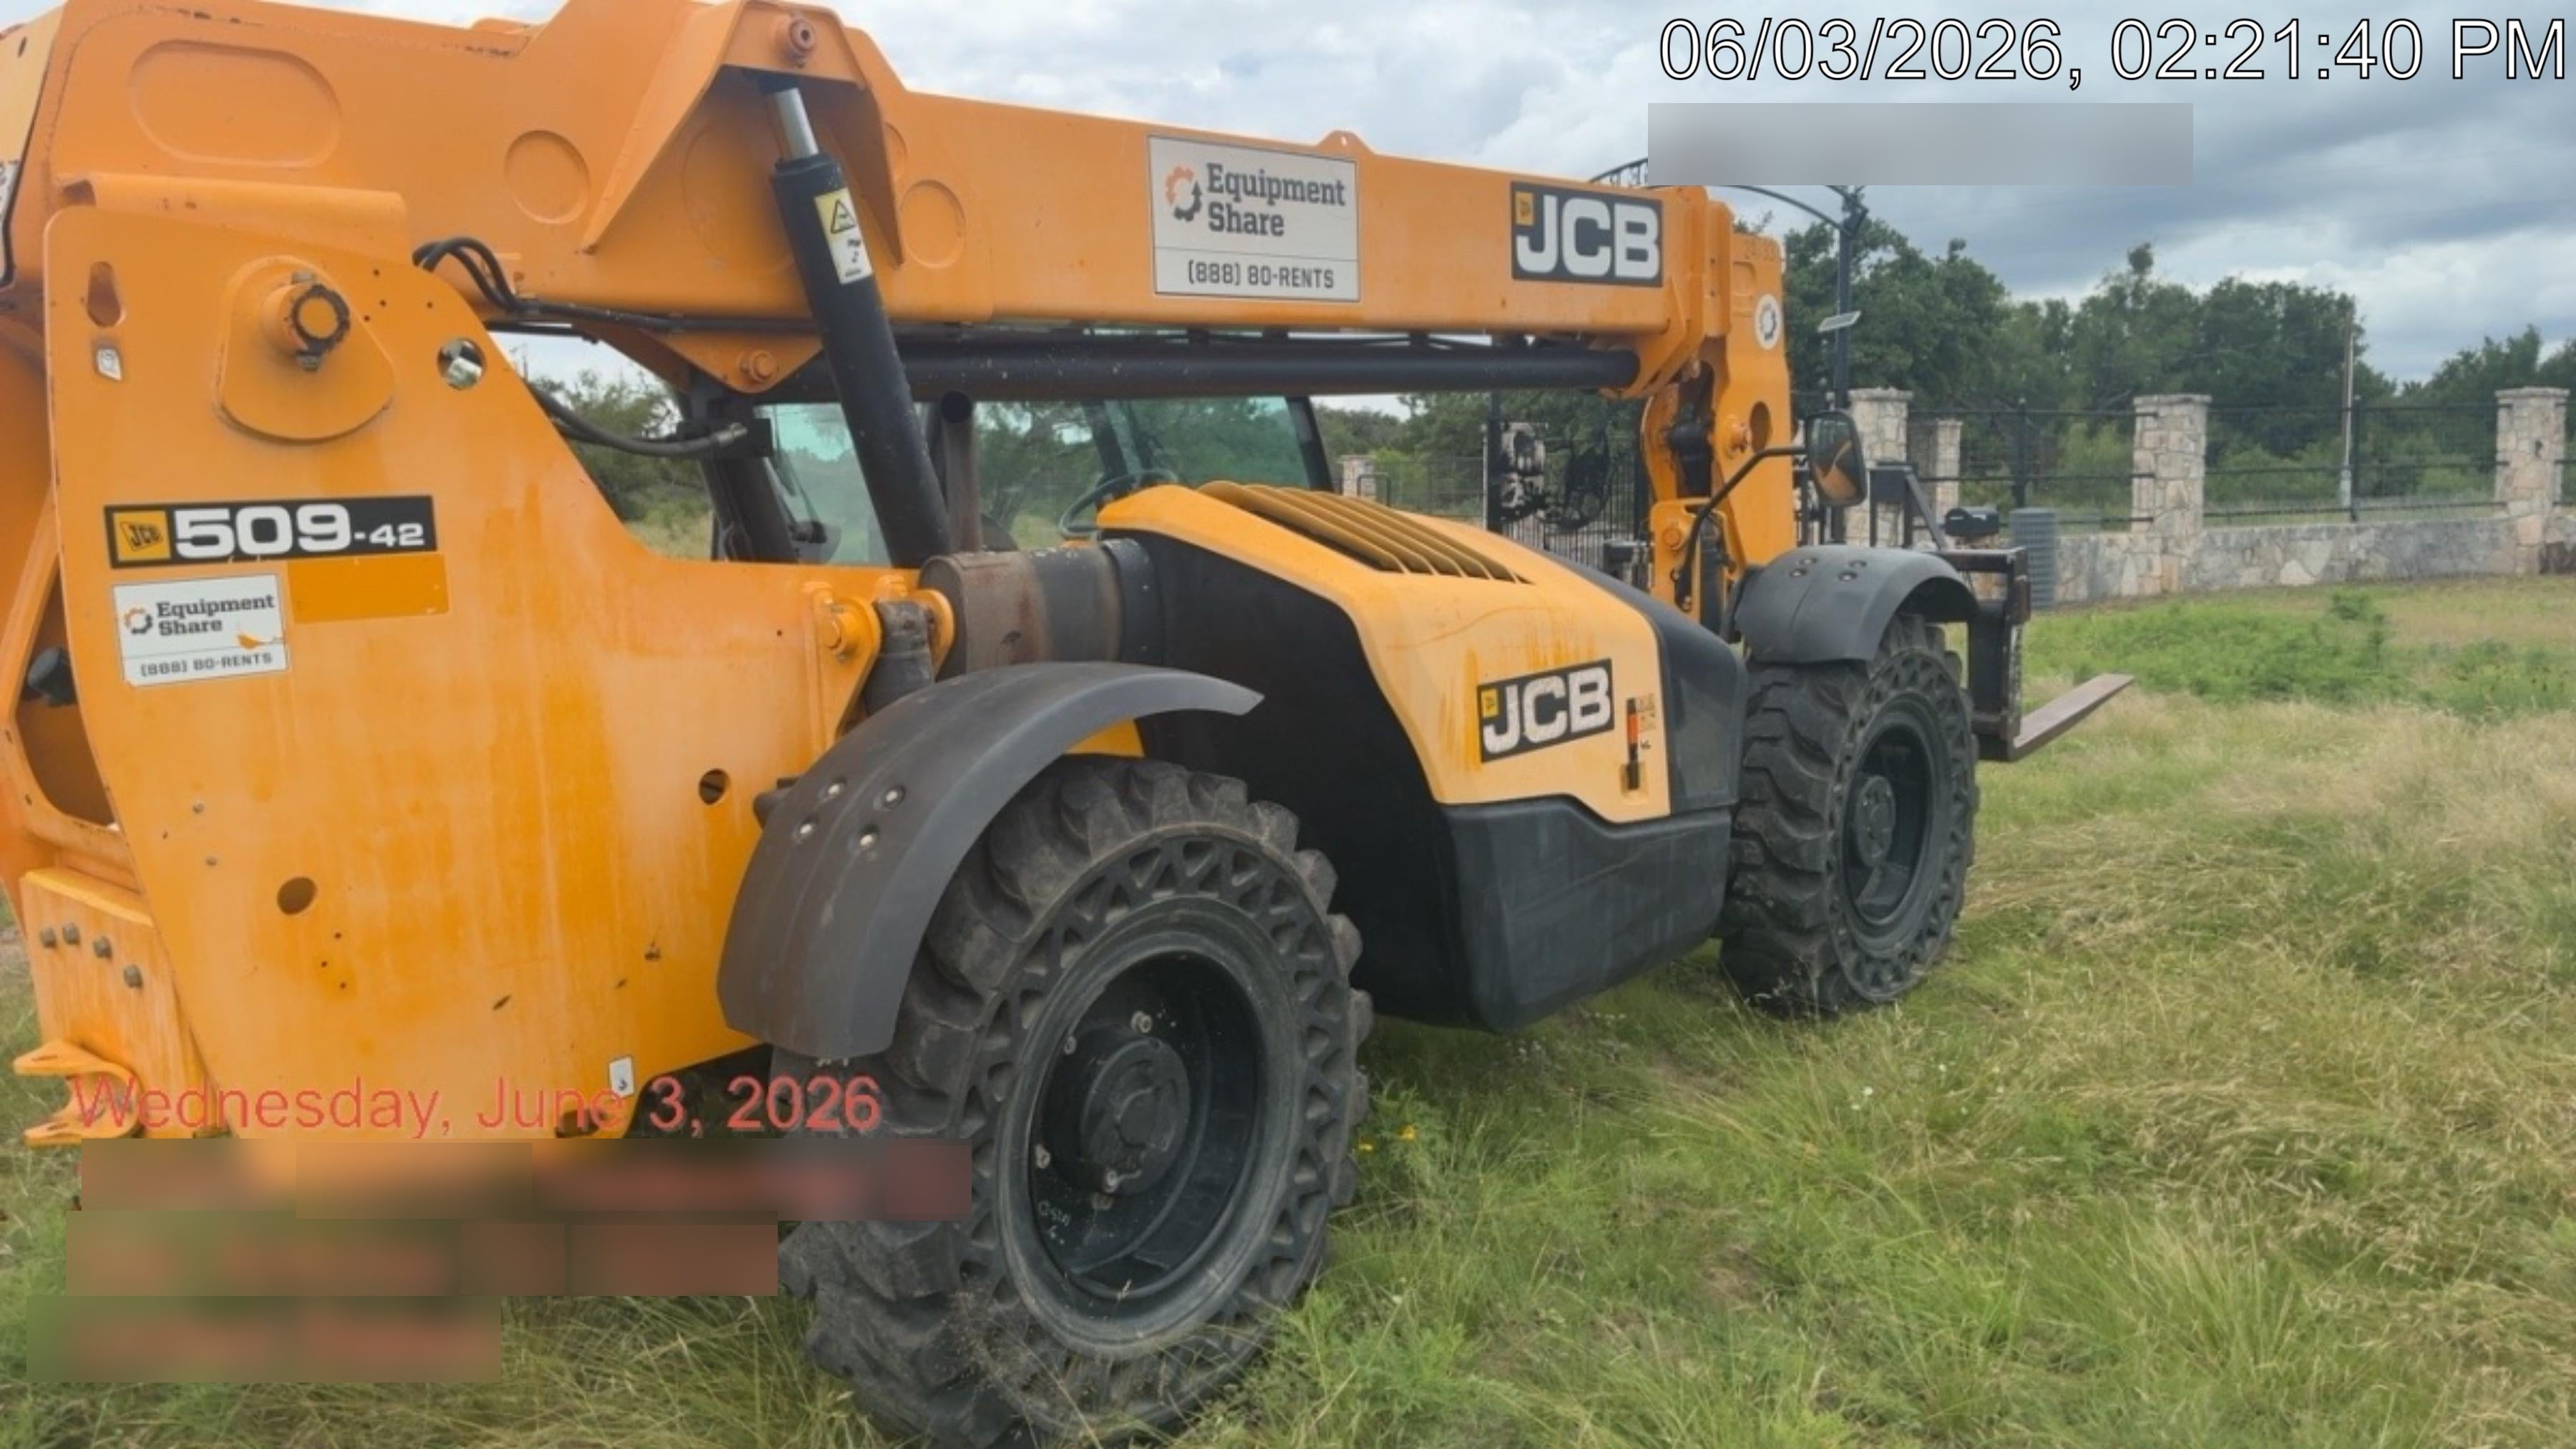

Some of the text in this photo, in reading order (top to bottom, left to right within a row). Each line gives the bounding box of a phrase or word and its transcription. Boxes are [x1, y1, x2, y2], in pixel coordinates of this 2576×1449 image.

[1206, 162, 1346, 206] Equipment
[1207, 200, 1285, 237] Share
[1516, 194, 1660, 279] JCB
[1188, 259, 1335, 288] (888) 80-RENTS
[174, 504, 425, 559] 509-42
[156, 594, 275, 619] Equipment
[157, 618, 223, 638] Share
[140, 653, 273, 677] (888) 80-RENTS
[1483, 666, 1611, 753] JCB
